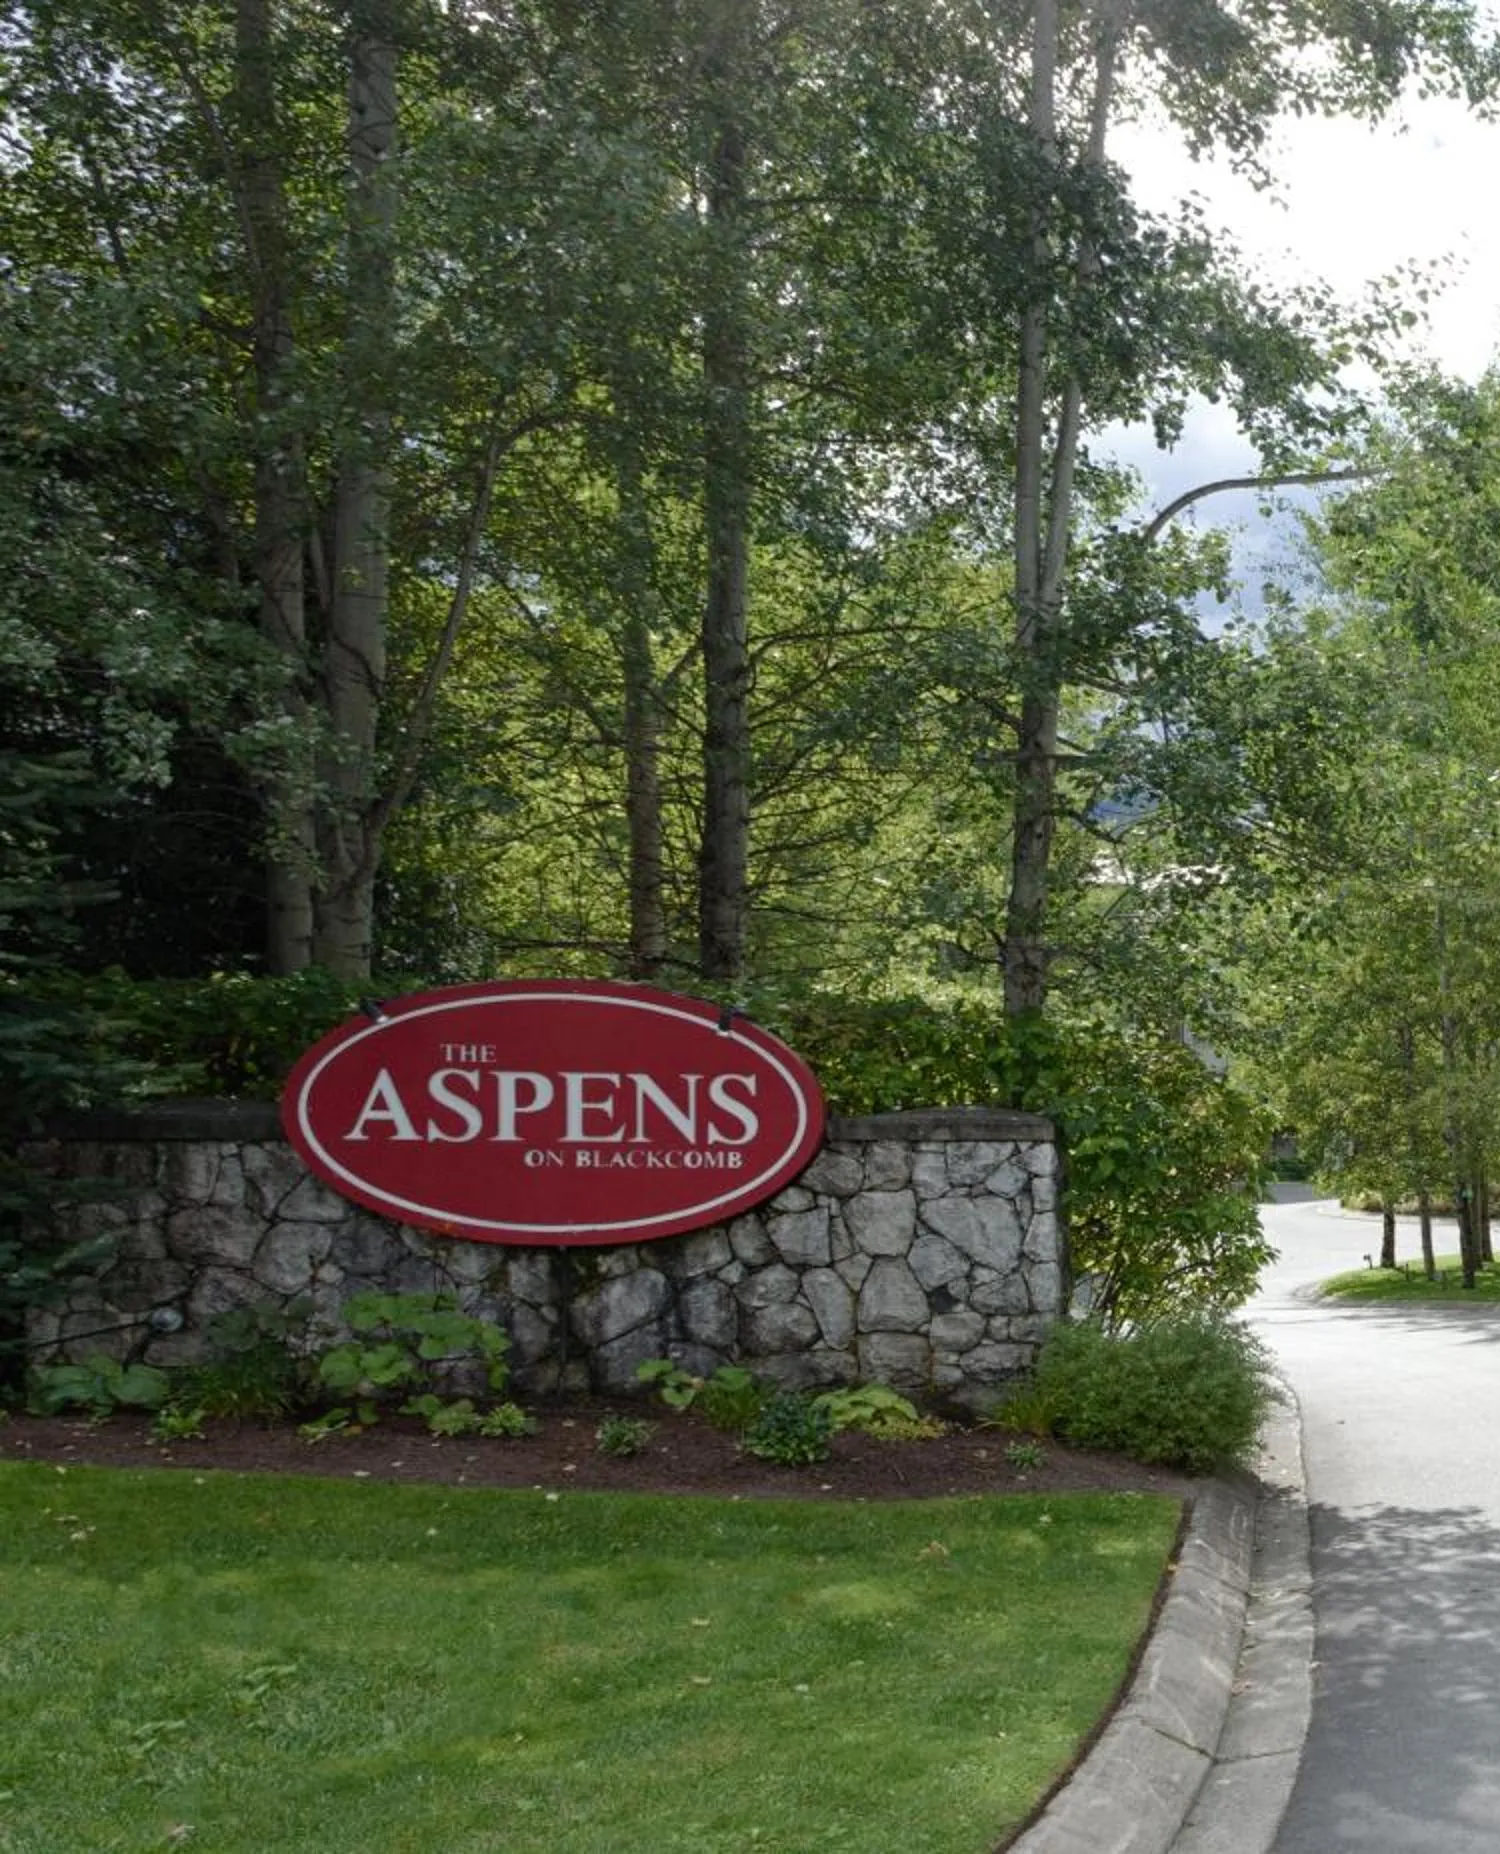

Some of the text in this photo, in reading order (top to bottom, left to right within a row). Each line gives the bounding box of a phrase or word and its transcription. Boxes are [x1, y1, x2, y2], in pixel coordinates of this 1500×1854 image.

[442, 1044, 496, 1062] THE
[343, 1069, 758, 1144] ASPENS
[524, 1149, 742, 1168] ON BLACKCOMB
